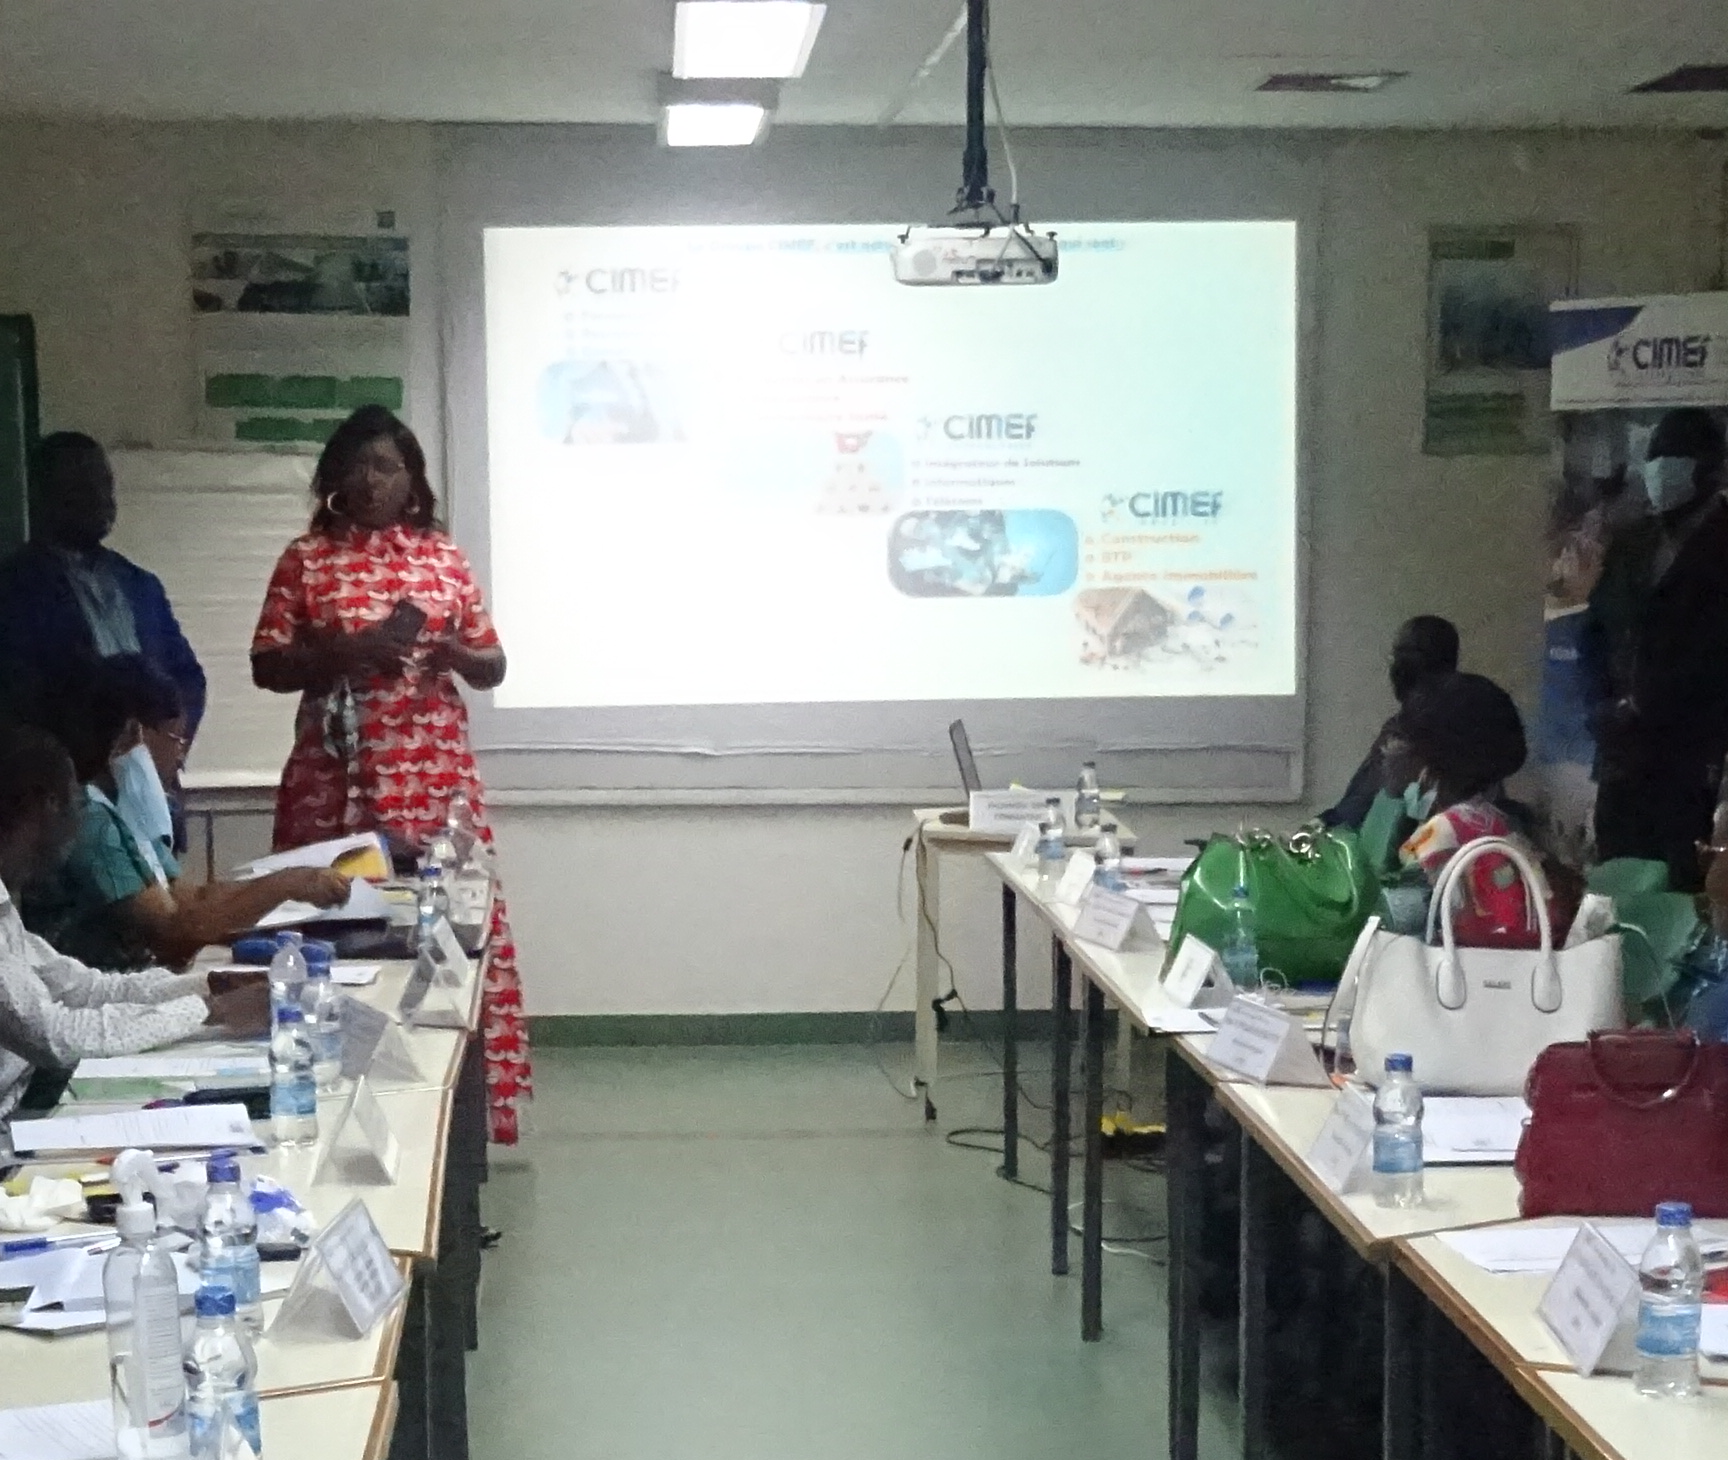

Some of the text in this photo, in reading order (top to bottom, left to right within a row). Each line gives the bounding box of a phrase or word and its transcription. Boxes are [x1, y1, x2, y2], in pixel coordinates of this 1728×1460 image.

[585, 267, 680, 294] CIMEF
[1632, 335, 1712, 370] CIMEF
[943, 413, 1037, 439] CIMEF
[1128, 490, 1223, 518] CIMEF
